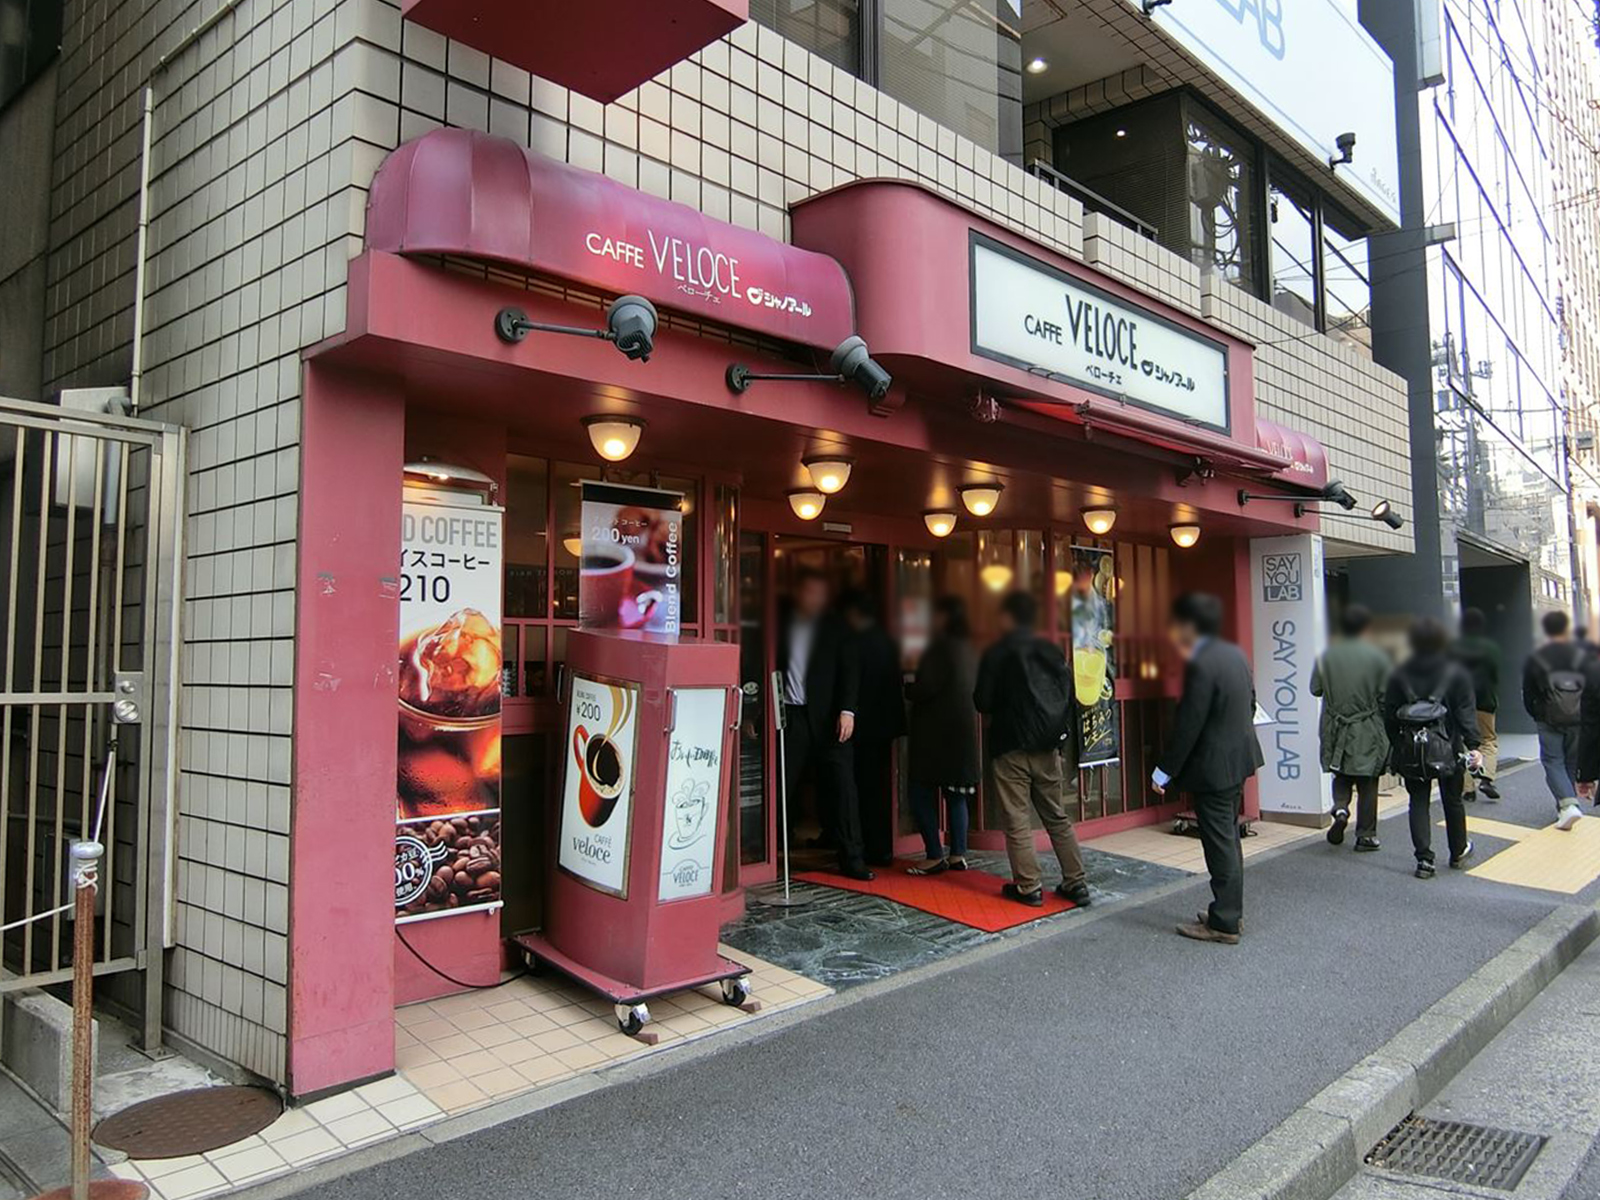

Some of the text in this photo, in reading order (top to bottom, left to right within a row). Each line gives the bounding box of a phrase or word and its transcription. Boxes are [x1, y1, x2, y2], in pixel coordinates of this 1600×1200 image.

[585, 229, 742, 299] CAFFE VELOCE
[677, 284, 722, 305] ベローチェ
[763, 291, 813, 318] シャノアール
[1024, 293, 1138, 370] CAFFE VELOCE
[1155, 367, 1196, 393] シャノアール
[421, 515, 498, 548] COFFEE
[591, 526, 640, 545] 200 yen
[1266, 555, 1298, 571] SAY
[665, 522, 678, 633] Blend Coffee
[1266, 570, 1299, 586] YOU
[1268, 586, 1300, 601] LAB
[1272, 620, 1297, 668] SAY
[576, 700, 601, 721] ¥200
[1273, 671, 1299, 726] YOU
[1276, 731, 1301, 780] LAB
[572, 836, 612, 864] veloce
[673, 869, 700, 884] VELOCE
